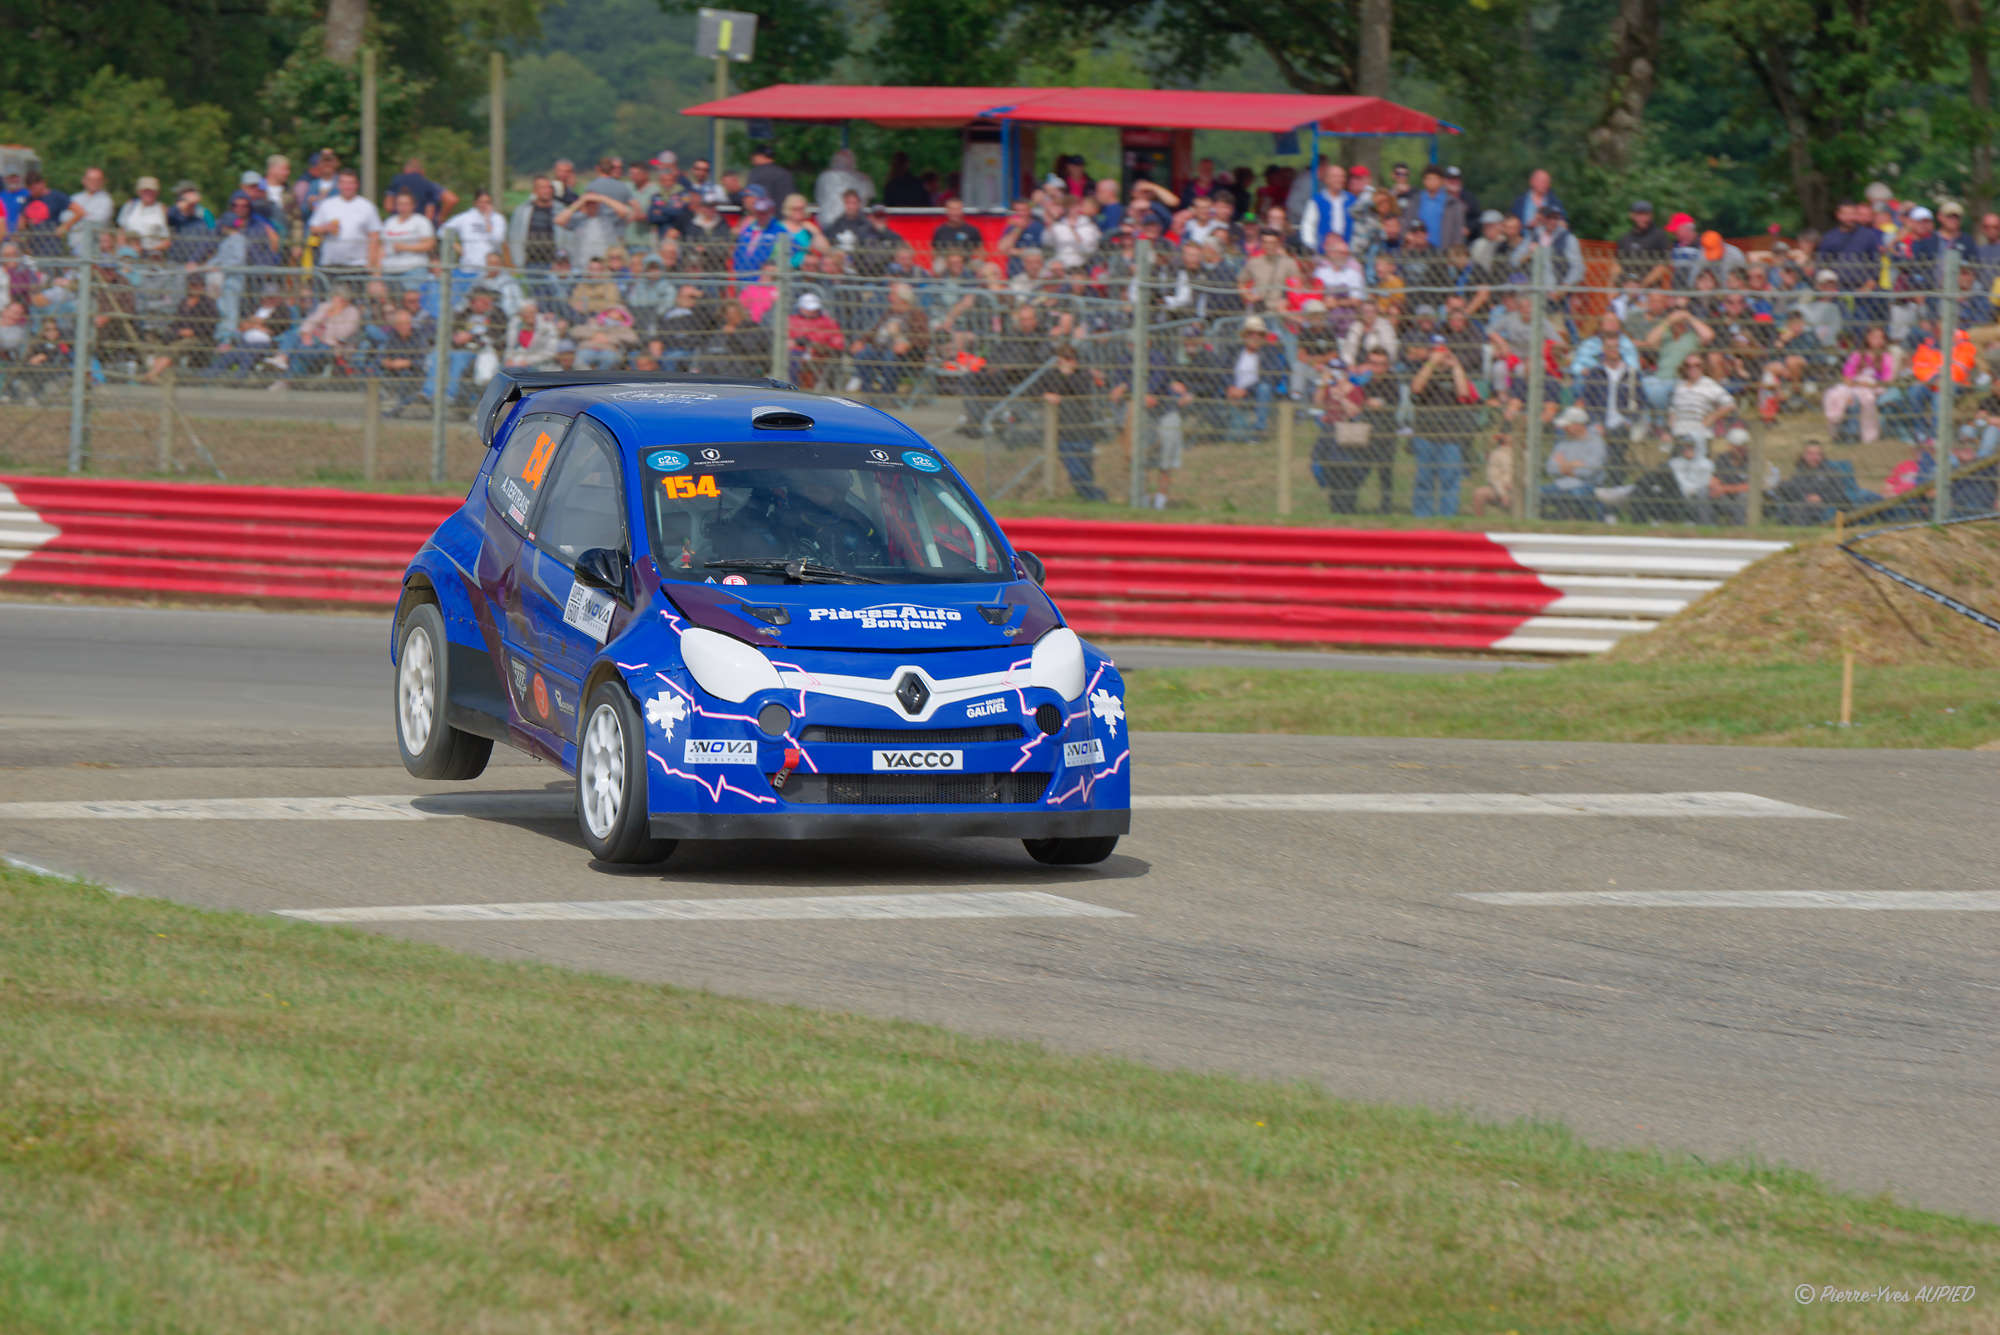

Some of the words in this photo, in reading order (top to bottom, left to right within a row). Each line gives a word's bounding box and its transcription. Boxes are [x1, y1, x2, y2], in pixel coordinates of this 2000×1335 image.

[658, 455, 679, 465] c2c
[661, 475, 721, 499] 154
[582, 598, 611, 624] NOVA
[808, 607, 898, 622] Pièces
[899, 606, 962, 621] Auto
[861, 617, 947, 631] Bonjour
[966, 702, 1009, 719] GALIVEL
[690, 741, 753, 754] NOVA
[881, 752, 955, 768] YACCO
